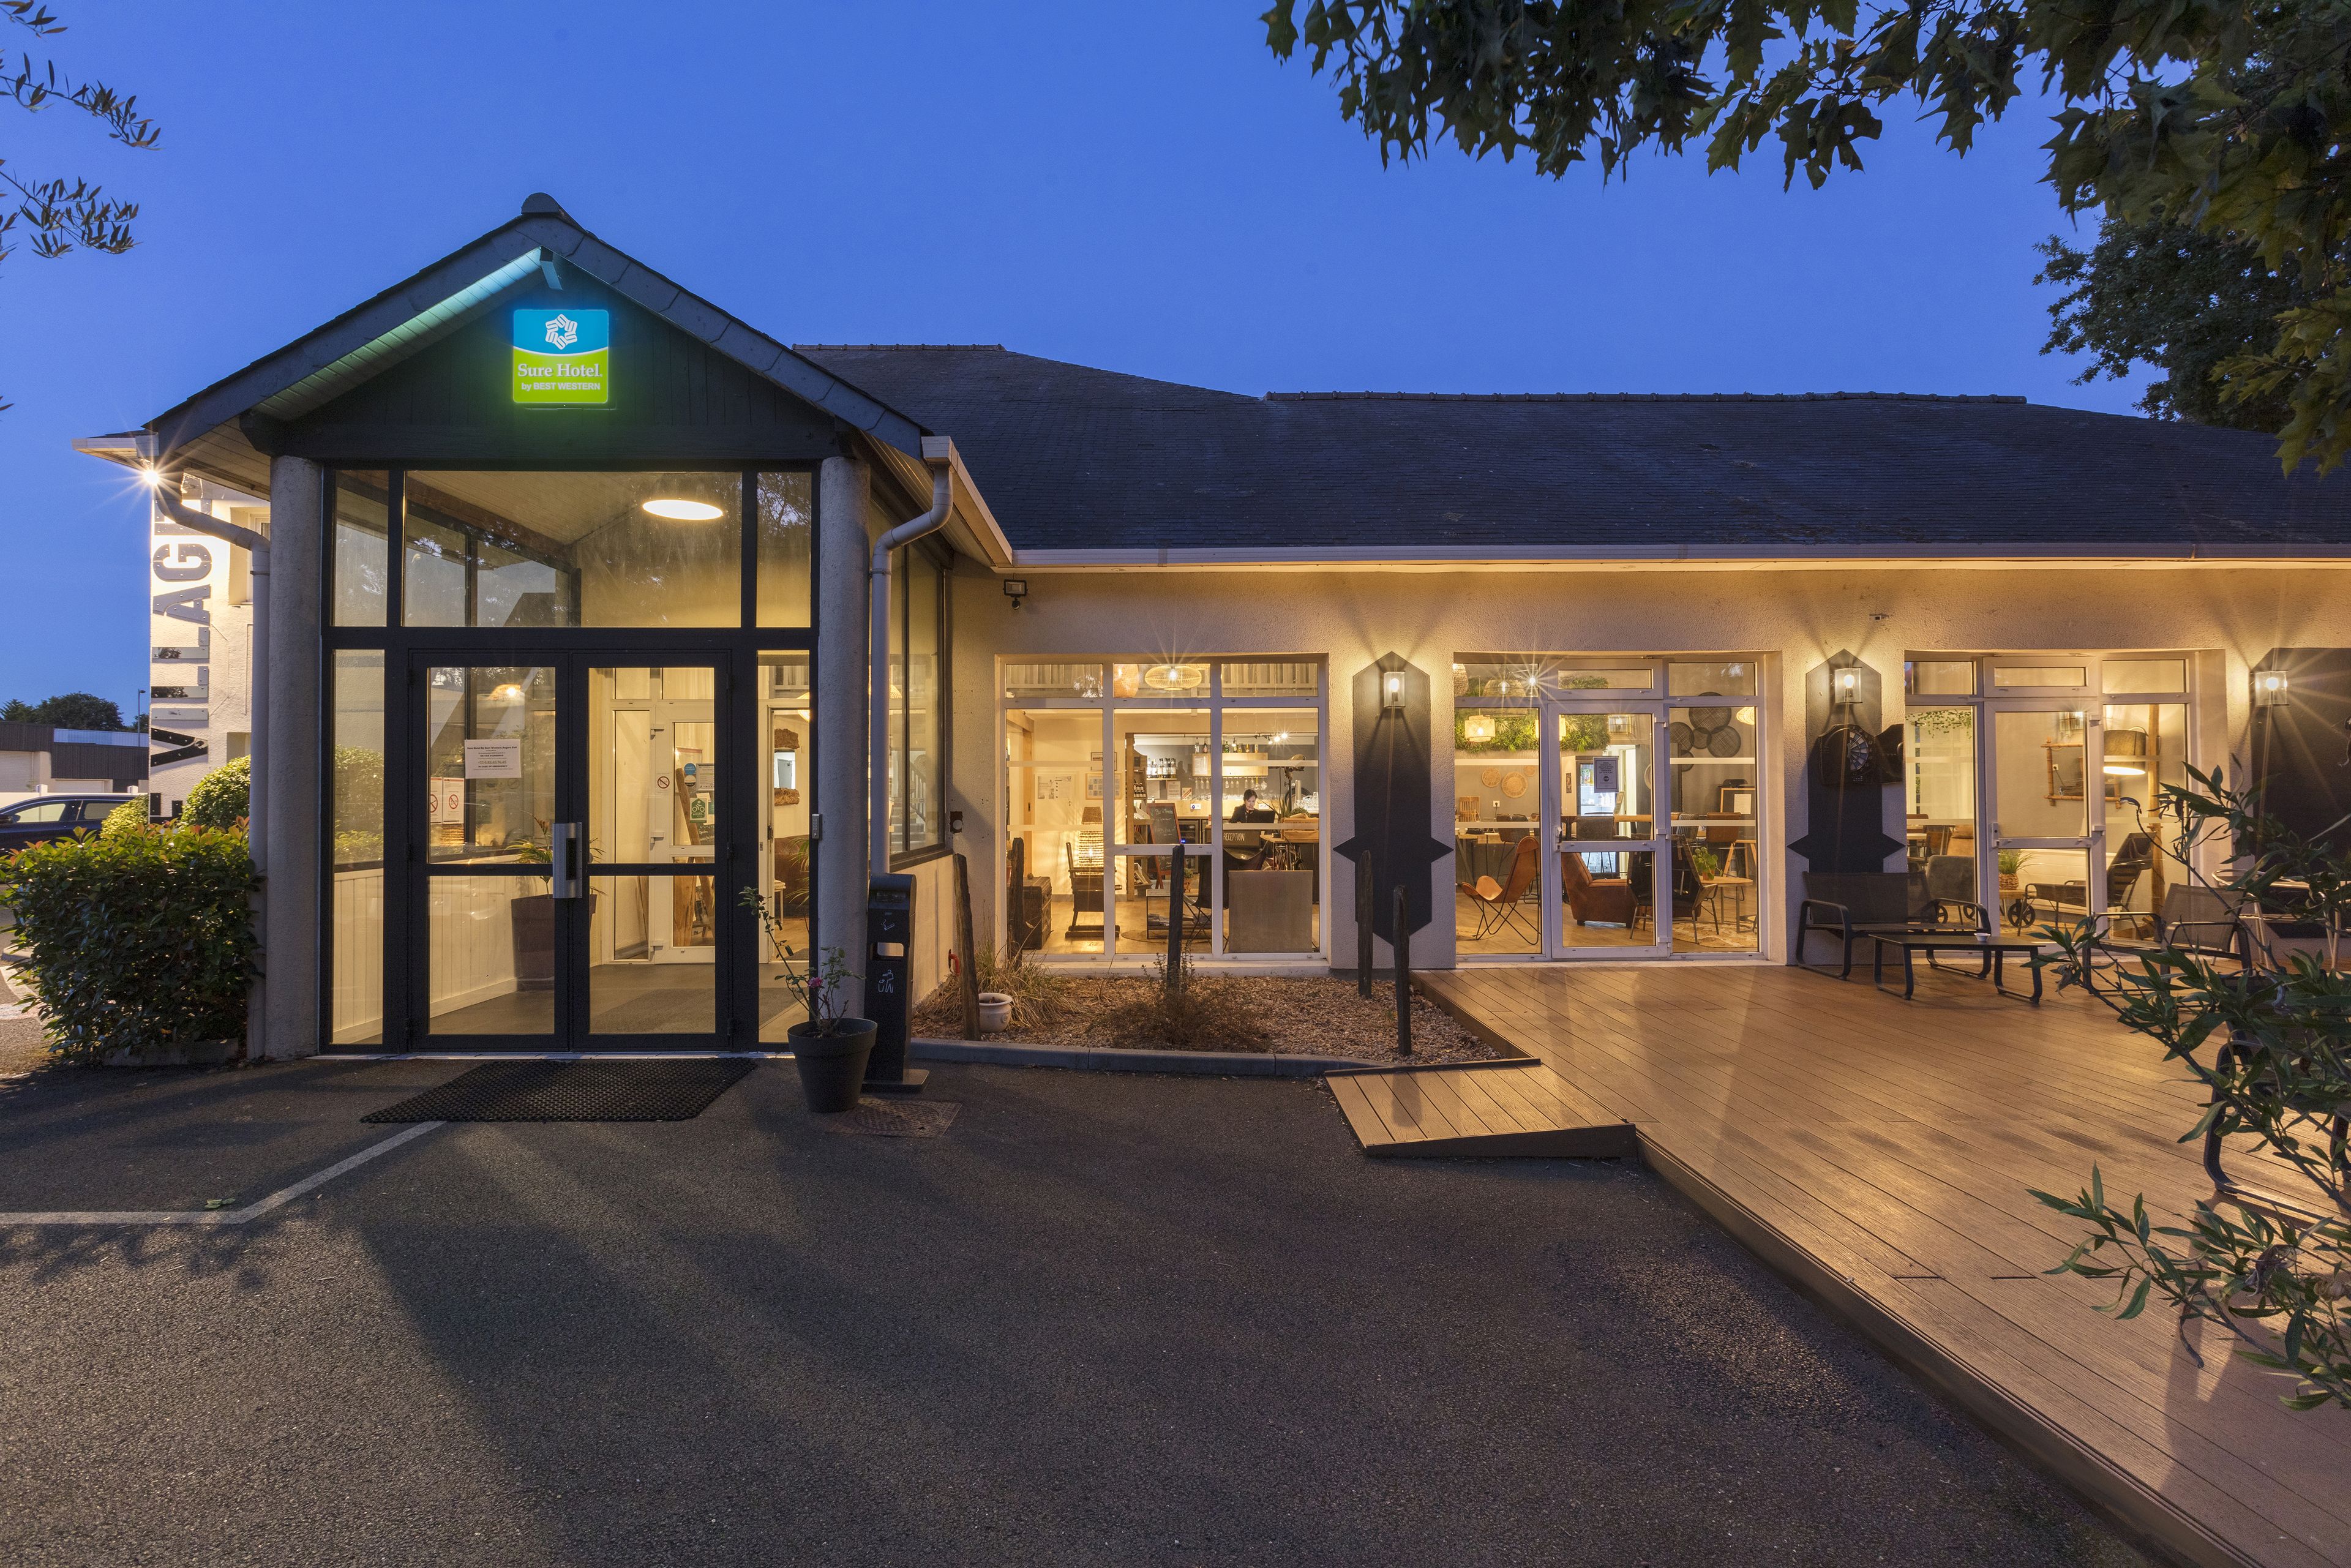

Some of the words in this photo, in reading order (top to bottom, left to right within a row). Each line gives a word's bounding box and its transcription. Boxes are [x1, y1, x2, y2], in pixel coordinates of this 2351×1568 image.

[517, 363, 553, 377] Sure
[521, 382, 532, 392] by
[1223, 833, 1245, 841] RECEPTION
